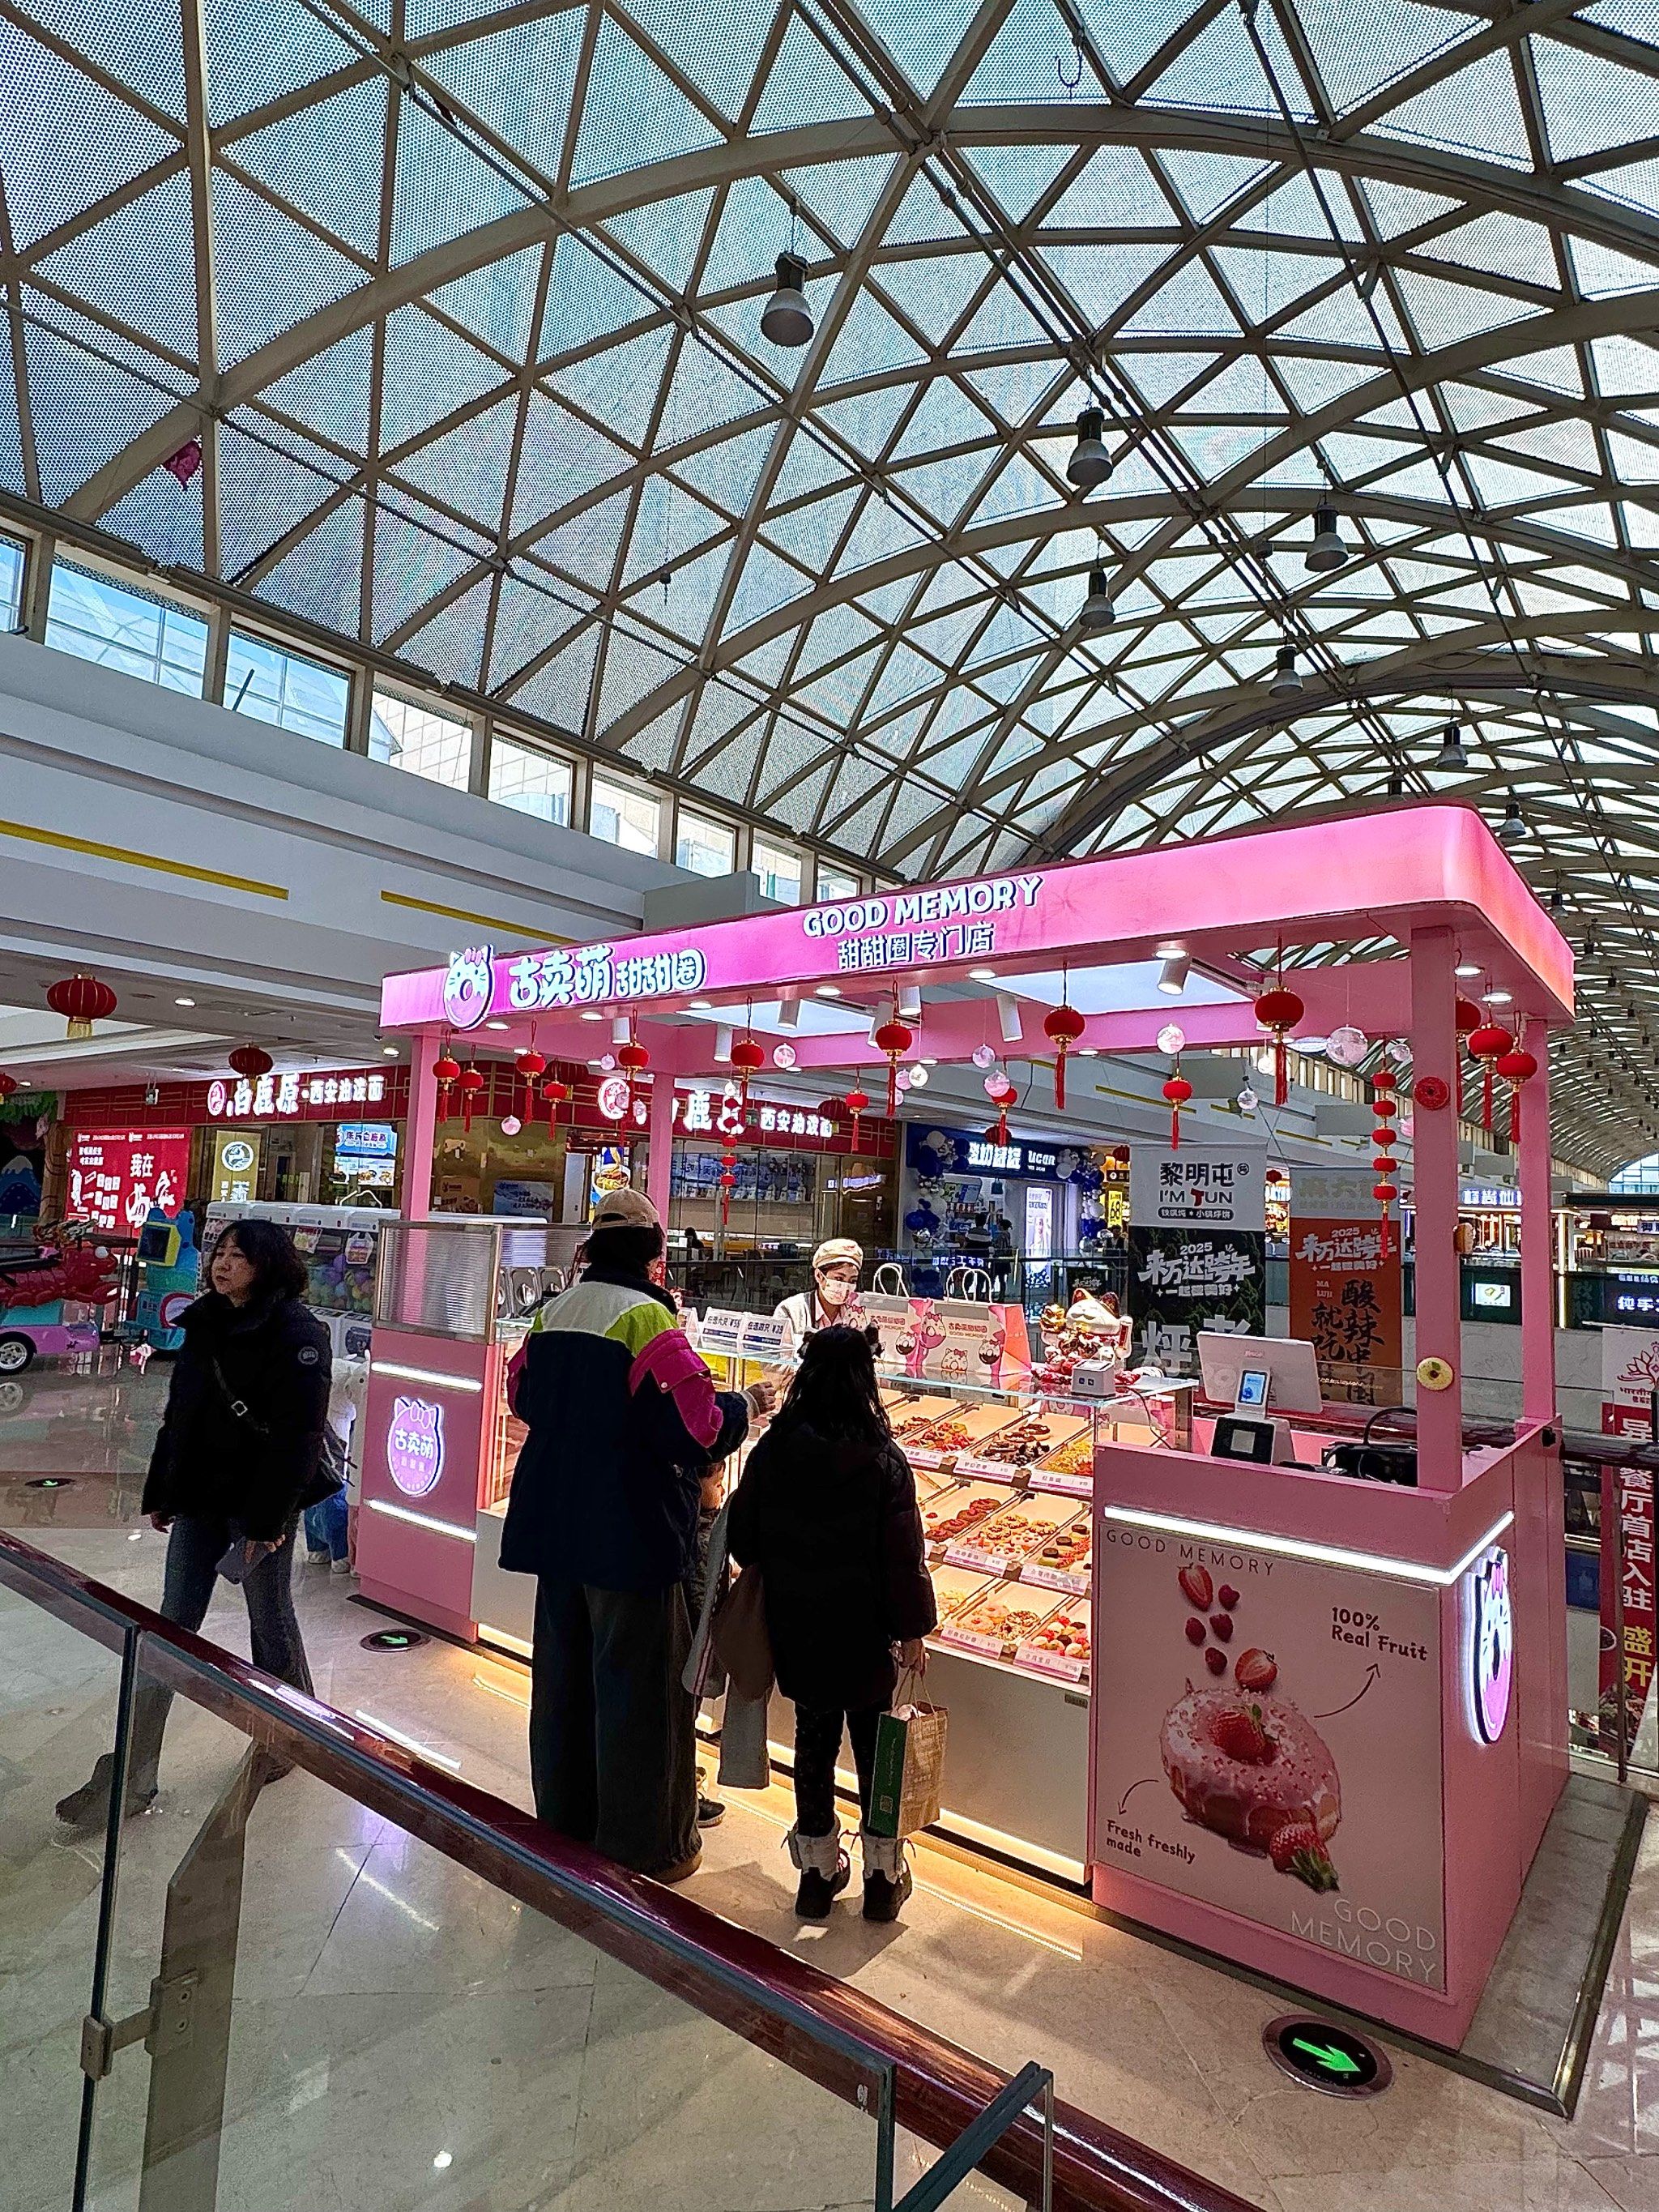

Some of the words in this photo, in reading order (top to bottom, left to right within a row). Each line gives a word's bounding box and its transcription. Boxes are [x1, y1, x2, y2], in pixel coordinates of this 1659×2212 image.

[804, 900, 887, 937] GOOD
[894, 876, 1043, 925] MEMORY
[838, 921, 994, 969] 甜甜圈专门店
[510, 945, 616, 1008] 古卖萌
[616, 949, 706, 997] 甜甜圈
[1160, 1162, 1235, 1187] 黎明屯
[1159, 1190, 1184, 1202] I'M
[1190, 1188, 1232, 1206] TUN
[1179, 1242, 1213, 1255] 2025
[1332, 1228, 1360, 1238] 2025
[1137, 1249, 1256, 1285] 来万达跨年
[394, 1428, 434, 1459] 古卖萌
[1107, 1529, 1166, 1552] GOOD
[1180, 1544, 1274, 1576] MEMORY
[1332, 1607, 1380, 1631] 100%
[1332, 1625, 1370, 1648] Real
[1378, 1635, 1427, 1661] Fruit
[1623, 1625, 1652, 1687] 盛开
[1106, 1837, 1141, 1857] made
[1107, 1819, 1142, 1843] Fresh
[1148, 1834, 1196, 1864] freshly
[1334, 1898, 1435, 1950] GOOD
[1291, 1911, 1436, 1984] MEMORY
